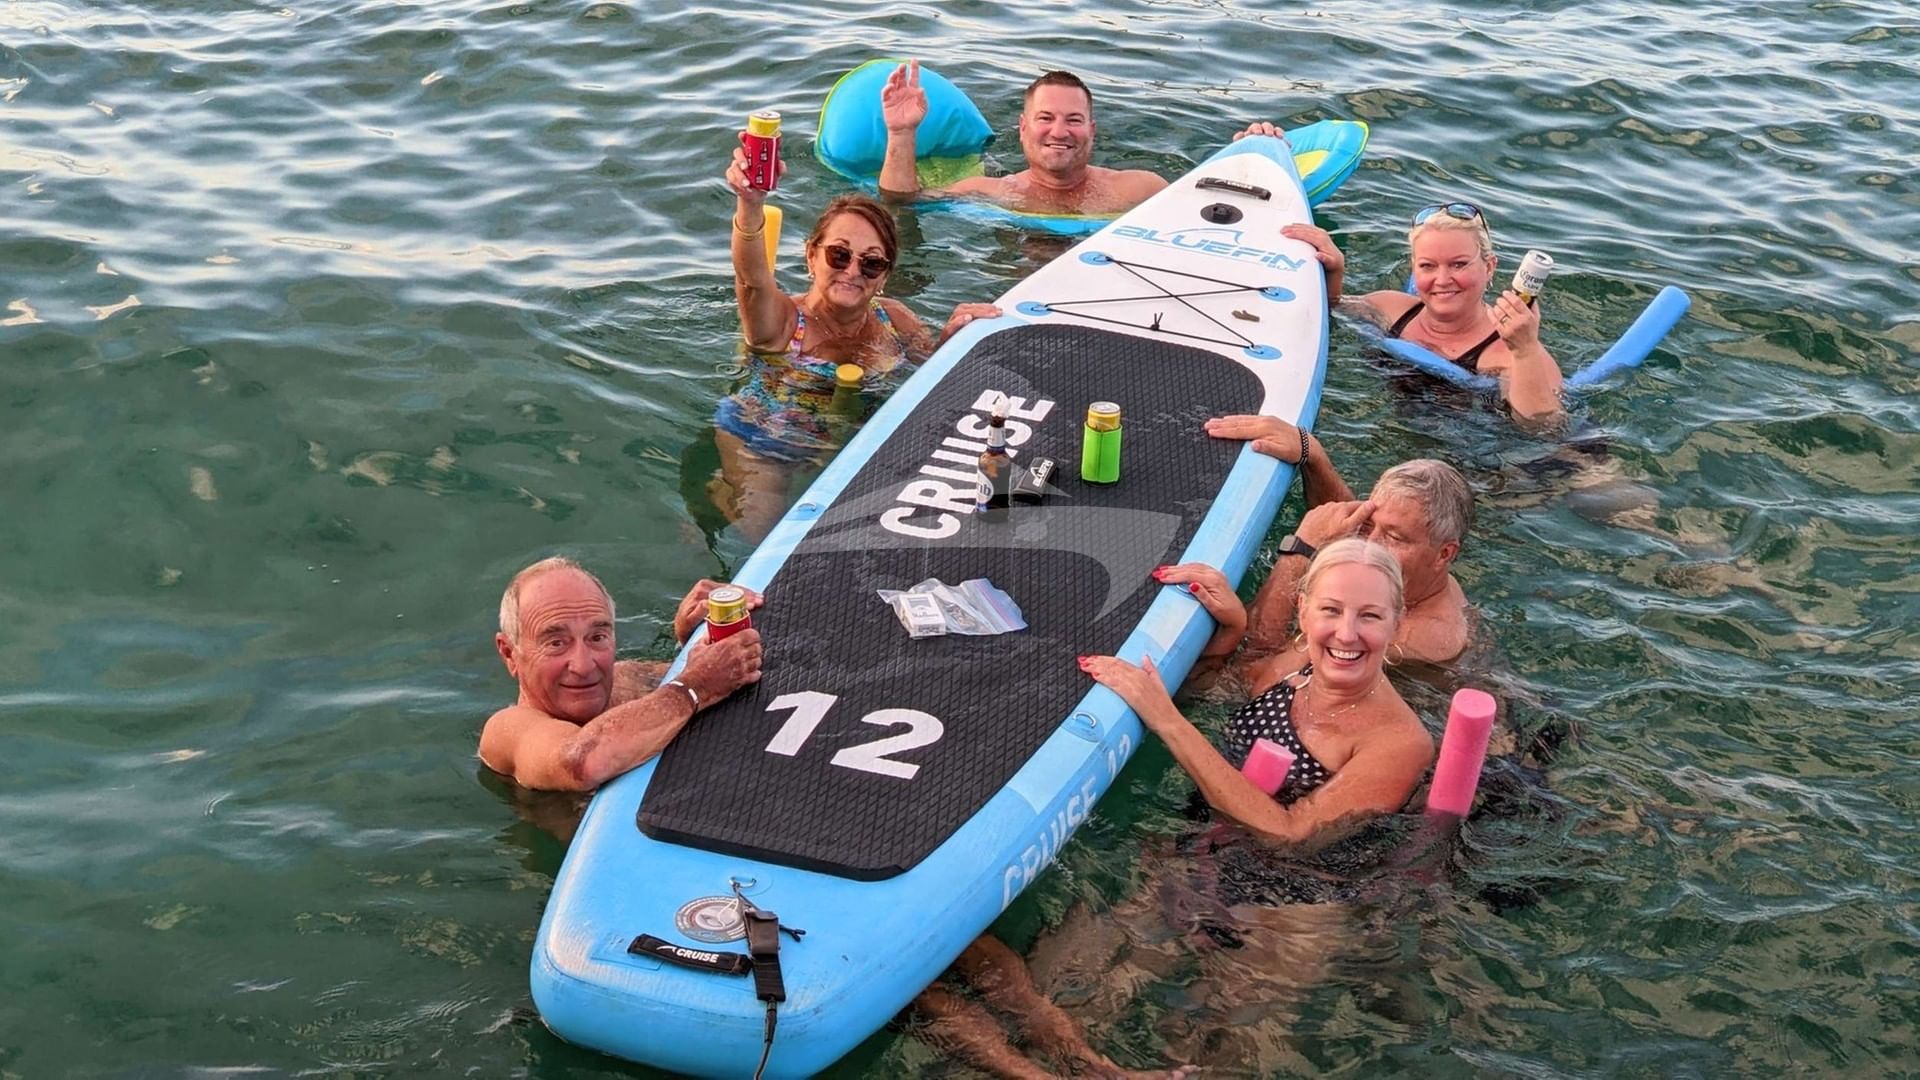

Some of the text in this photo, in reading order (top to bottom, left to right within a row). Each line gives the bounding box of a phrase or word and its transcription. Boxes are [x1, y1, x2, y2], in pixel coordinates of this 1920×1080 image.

[880, 389, 1056, 539] CRUISE
[765, 690, 945, 779] 12
[676, 948, 720, 963] CRUISE
